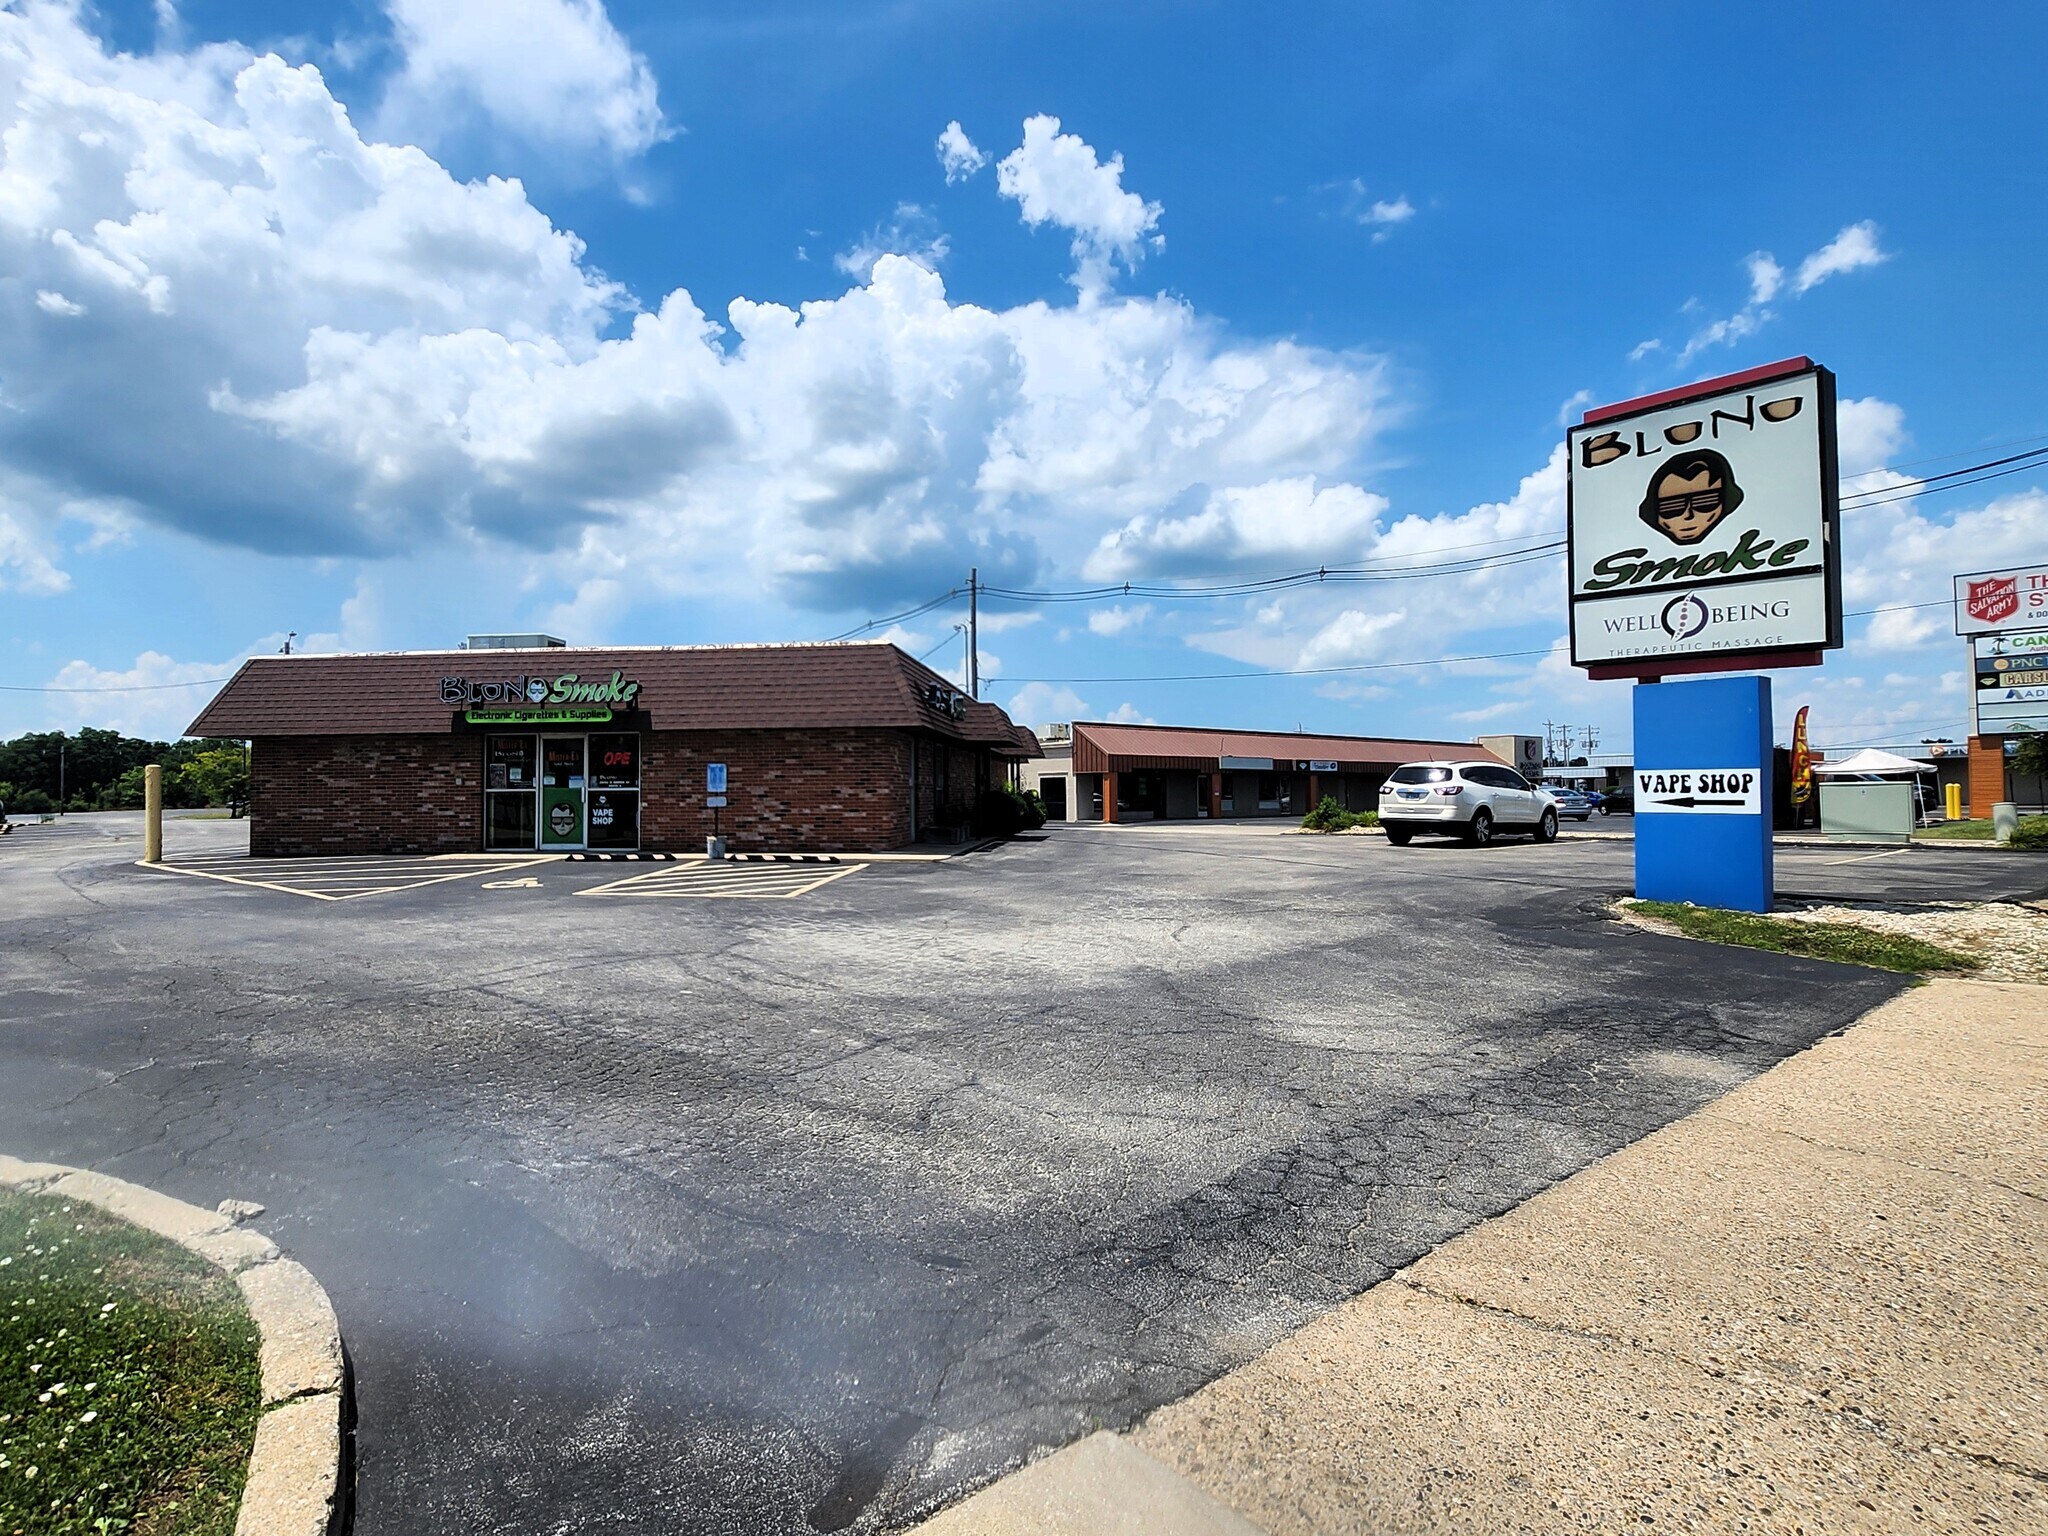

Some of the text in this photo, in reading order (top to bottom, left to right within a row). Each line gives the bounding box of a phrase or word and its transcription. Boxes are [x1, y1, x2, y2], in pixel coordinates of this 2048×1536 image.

[1583, 529, 1810, 590] Smoke
[1970, 581, 2014, 614] SALVATION
[1976, 581, 1997, 597] THE
[1986, 595, 2013, 619] ARMY
[2029, 592, 2048, 606] S
[1603, 600, 1791, 634] WELL BEING
[1609, 635, 1784, 657] THERAPEUTIC MASSAGE
[2011, 657, 2043, 667] PNC
[549, 670, 638, 703] Smoke
[2025, 689, 2048, 699] AD
[471, 710, 607, 722] Electronic Cigarettes & Supplies
[1640, 773, 1753, 794] VAPE SHOP
[592, 808, 614, 817] VAPE
[592, 817, 614, 825] SHOP
